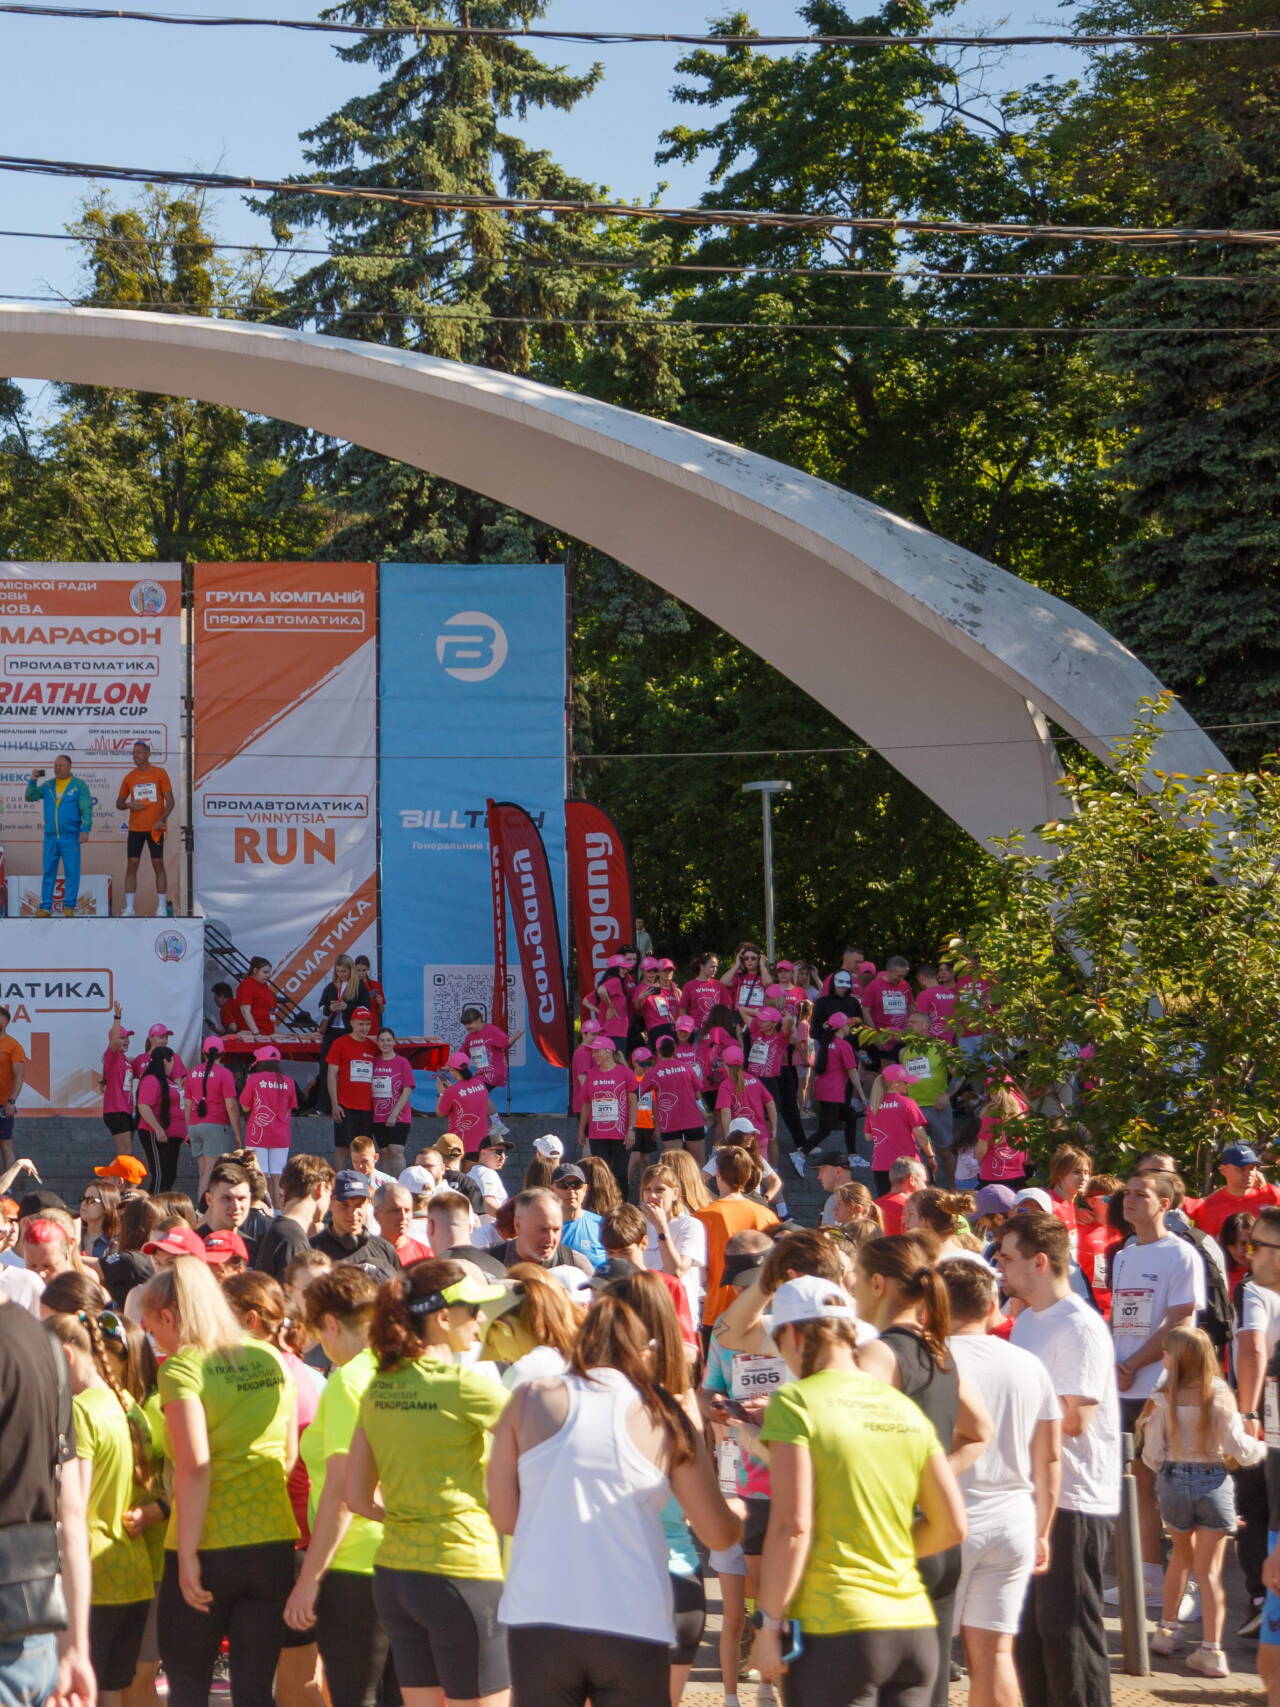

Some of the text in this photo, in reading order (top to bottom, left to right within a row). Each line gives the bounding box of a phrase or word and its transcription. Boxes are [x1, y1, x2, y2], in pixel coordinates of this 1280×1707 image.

[0, 580, 54, 591] МІСЬКОЇ
[58, 582, 97, 591] РАДИ
[205, 590, 365, 604] ГРУПА КОМПАНІЙ
[209, 614, 361, 626] ПРОМАВТОМАТИКА
[9, 661, 156, 671] ПРОМАВТОМАТИКА
[42, 706, 116, 716] VINNYTSIA
[120, 706, 148, 717] CUP
[207, 801, 365, 812] ПРОМАВТОМАТИКА
[246, 813, 327, 824] VINNYTSIA
[234, 828, 336, 865] RUN
[413, 841, 484, 853] Генеральний
[741, 1373, 780, 1386] 5165
